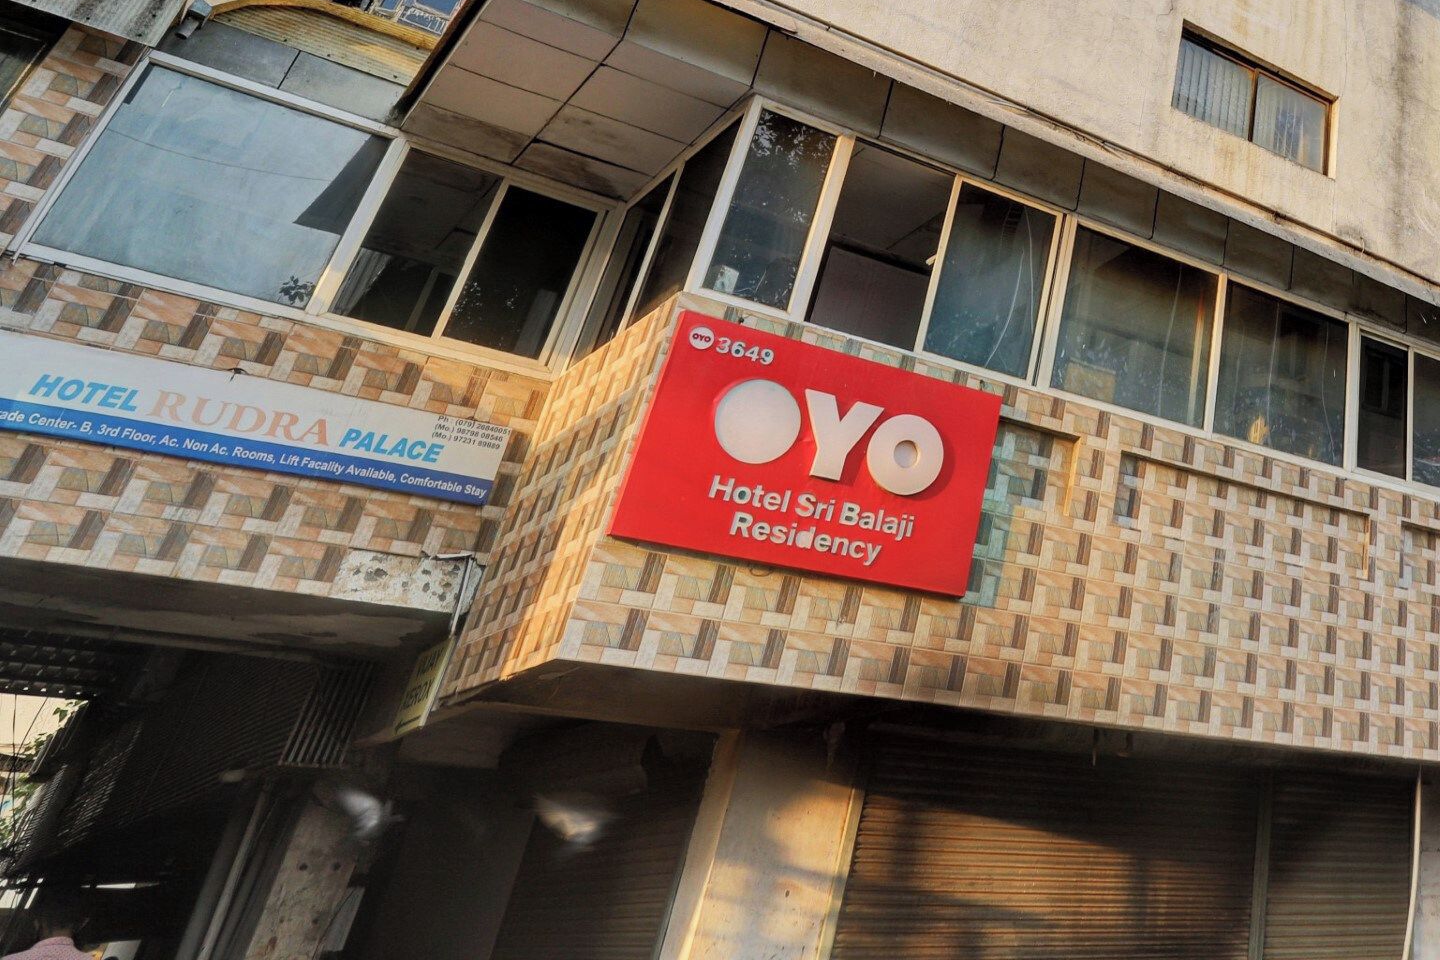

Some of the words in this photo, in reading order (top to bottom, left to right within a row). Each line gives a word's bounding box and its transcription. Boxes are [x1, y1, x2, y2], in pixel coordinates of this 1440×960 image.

[693, 333, 711, 343] OYO
[716, 337, 774, 365] 3649
[29, 374, 142, 413] HOTEL
[147, 389, 329, 447] RUDRA
[338, 428, 445, 463] PALACE
[714, 378, 944, 496] OYO
[80, 422, 93, 434] B,
[97, 424, 120, 437] 3rd
[122, 428, 156, 445] Floor,
[159, 435, 179, 447] Ac.
[183, 439, 208, 452] Non
[209, 444, 229, 456] Ac.
[231, 446, 276, 464] Rooms,
[279, 453, 300, 466] Lift
[301, 456, 344, 476] Facality
[346, 465, 397, 484] Available,
[400, 473, 462, 493] Comfortable
[464, 484, 488, 500] Stay
[708, 474, 790, 512] Hotel
[795, 491, 835, 521] Sri
[838, 501, 915, 541] Balaji
[729, 512, 882, 565] Residency
